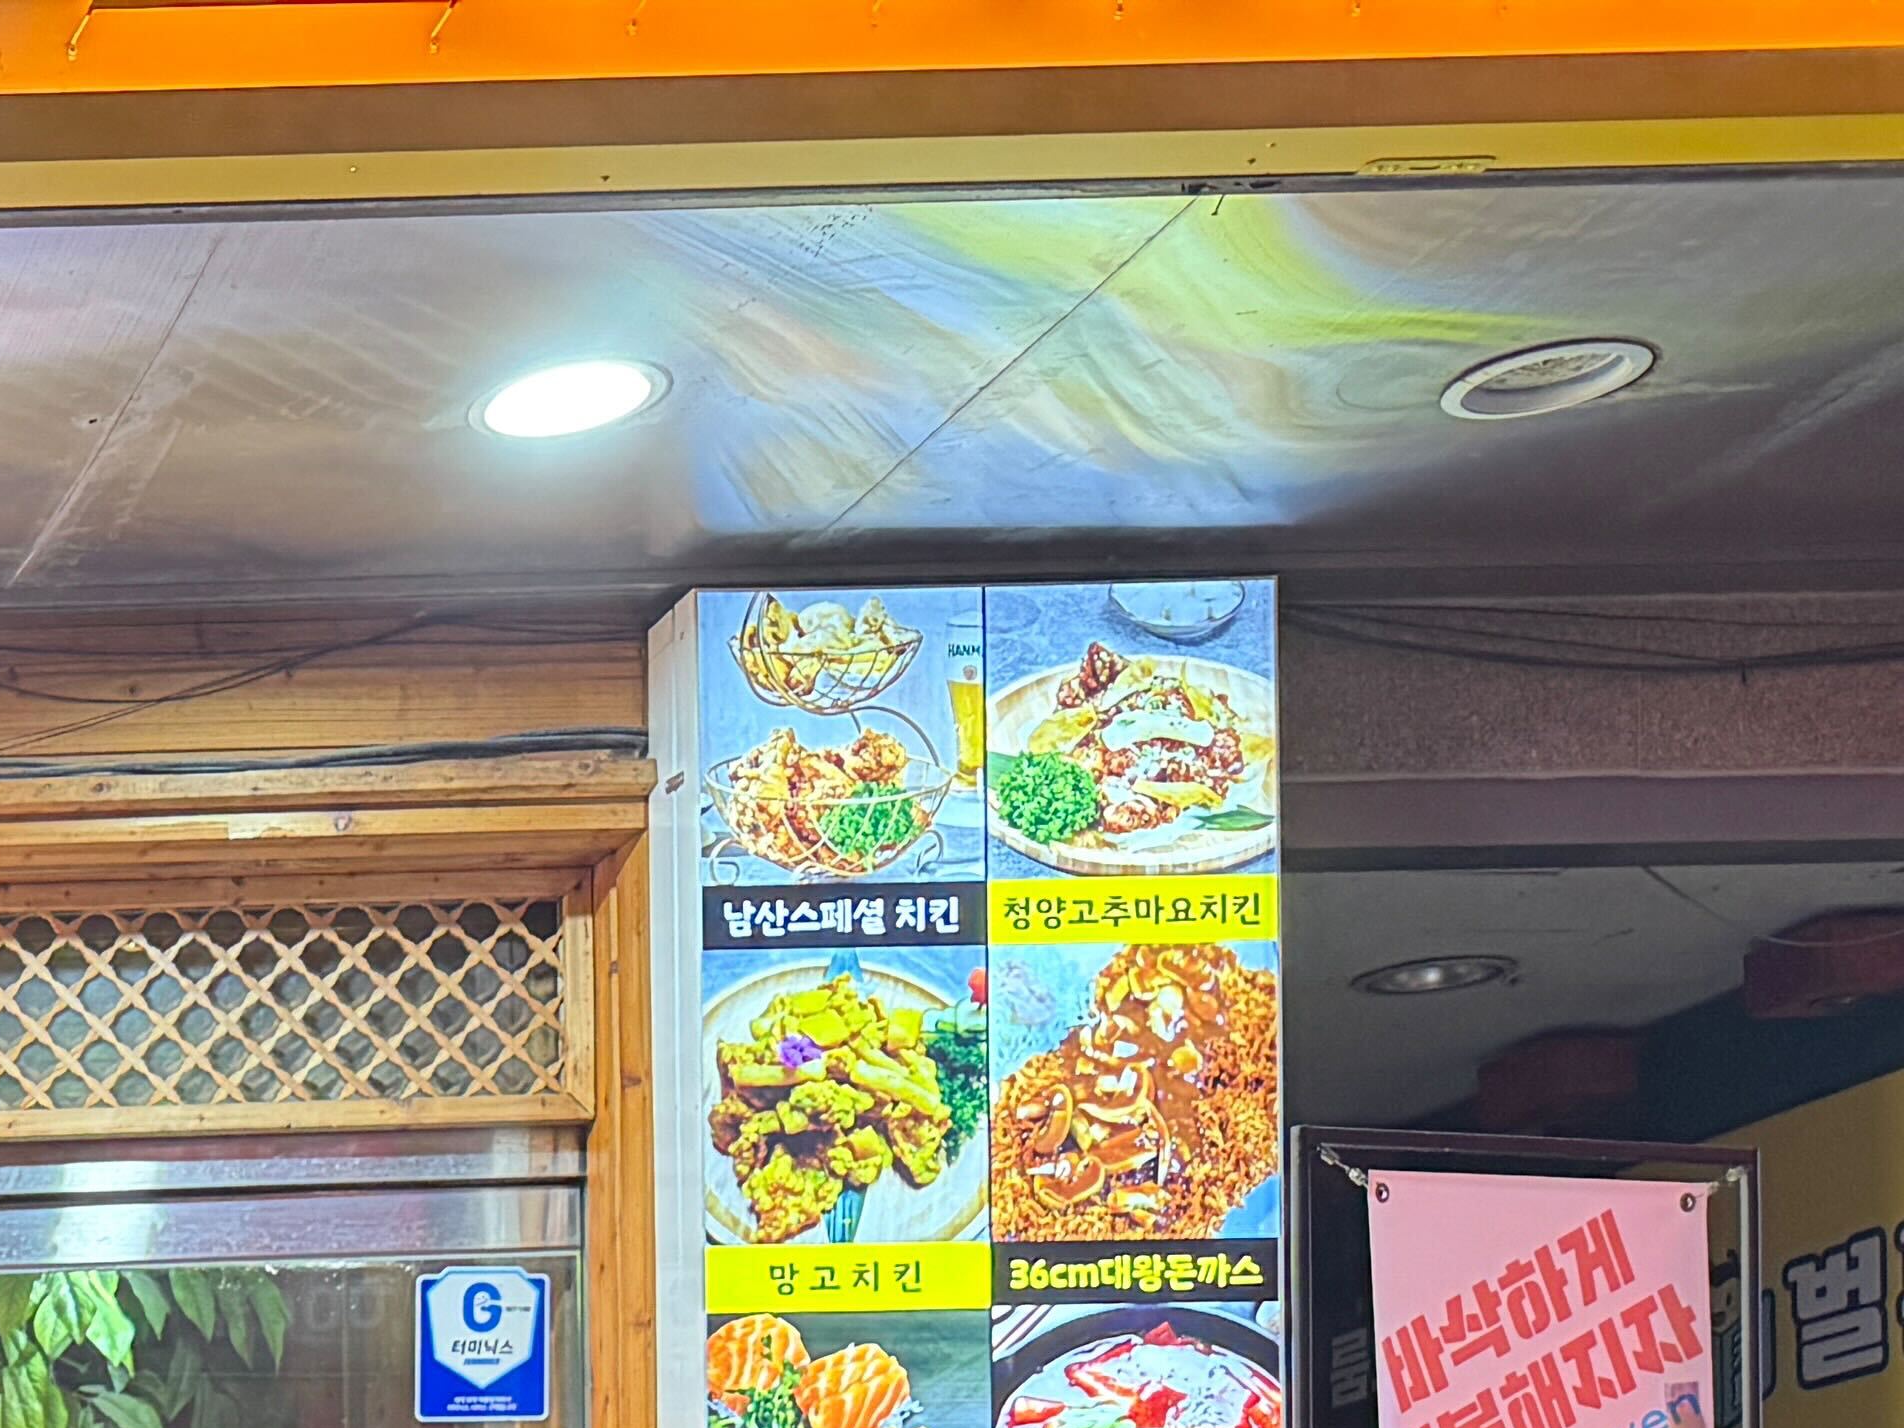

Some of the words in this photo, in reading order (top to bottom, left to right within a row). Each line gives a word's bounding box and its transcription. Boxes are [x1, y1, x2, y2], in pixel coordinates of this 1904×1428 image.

[724, 897, 886, 937] 남산스페셜
[895, 895, 961, 933] 치킨
[1004, 892, 1263, 930] 청양고추마요치킨
[769, 1261, 923, 1294] 망고치킨
[1009, 1253, 1264, 1289] 36cm대왕돈까스
[1381, 1208, 1636, 1413] 바삭하게
[452, 1339, 513, 1355] 터미닉스
